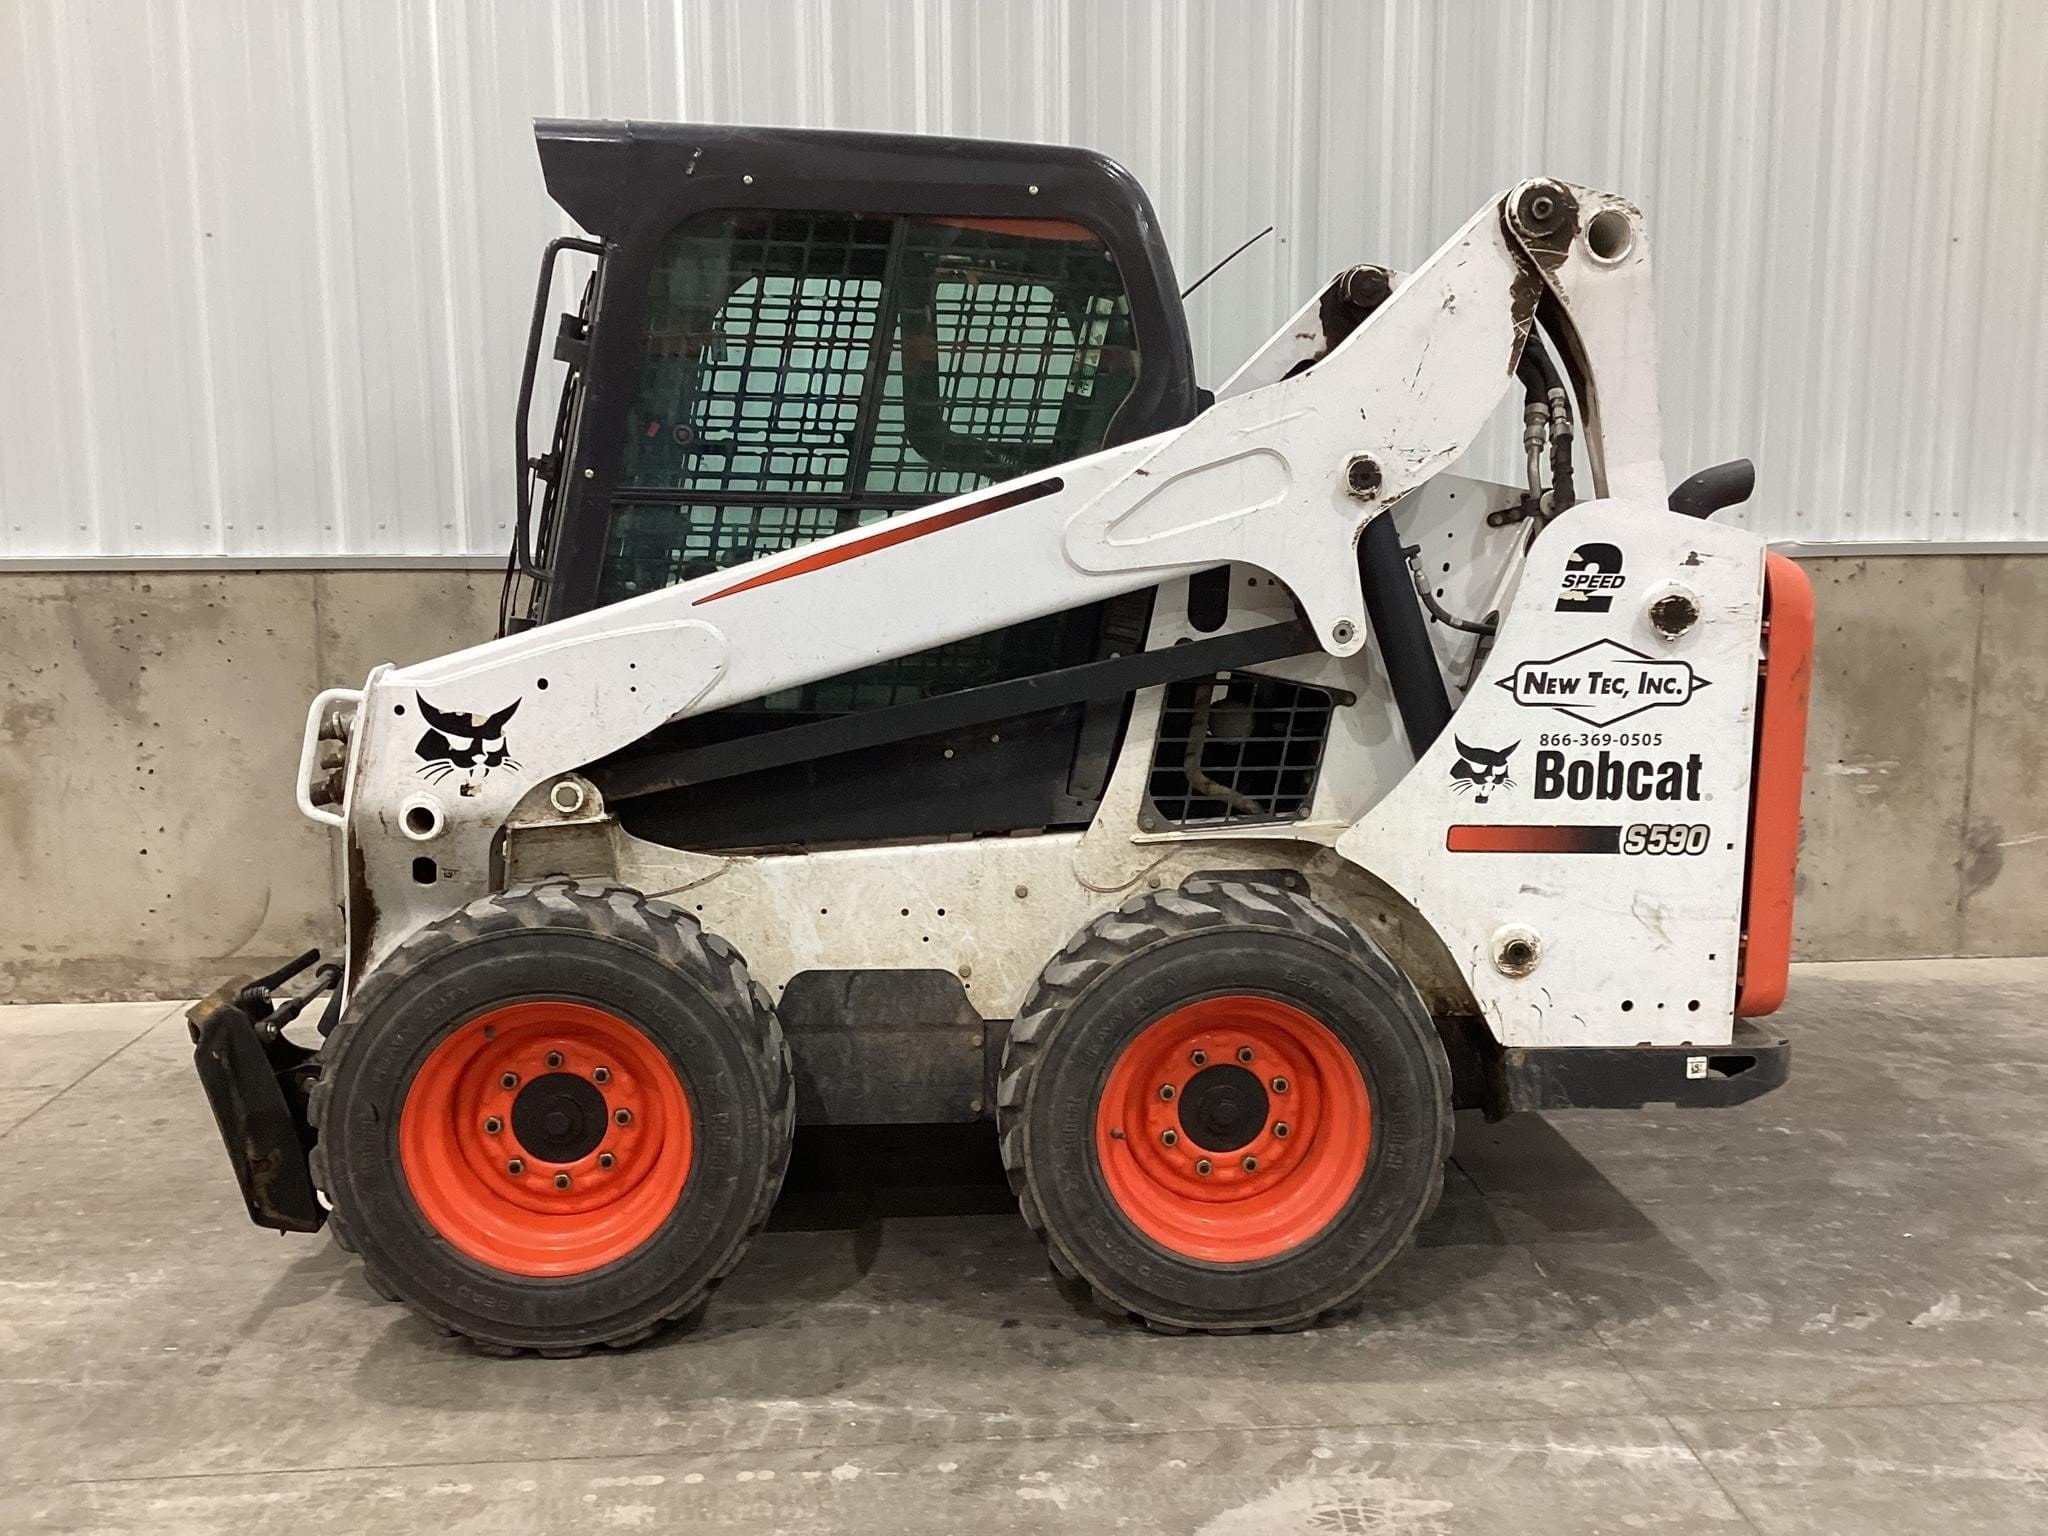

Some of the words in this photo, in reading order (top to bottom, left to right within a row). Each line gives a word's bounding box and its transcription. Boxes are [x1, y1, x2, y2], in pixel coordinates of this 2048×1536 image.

[1555, 543, 1623, 612] 2
[1562, 574, 1626, 589] SPEED
[1539, 733, 1663, 746] 866-369-0505
[1534, 750, 1703, 801] Bobcat
[1624, 823, 1711, 855] S590
